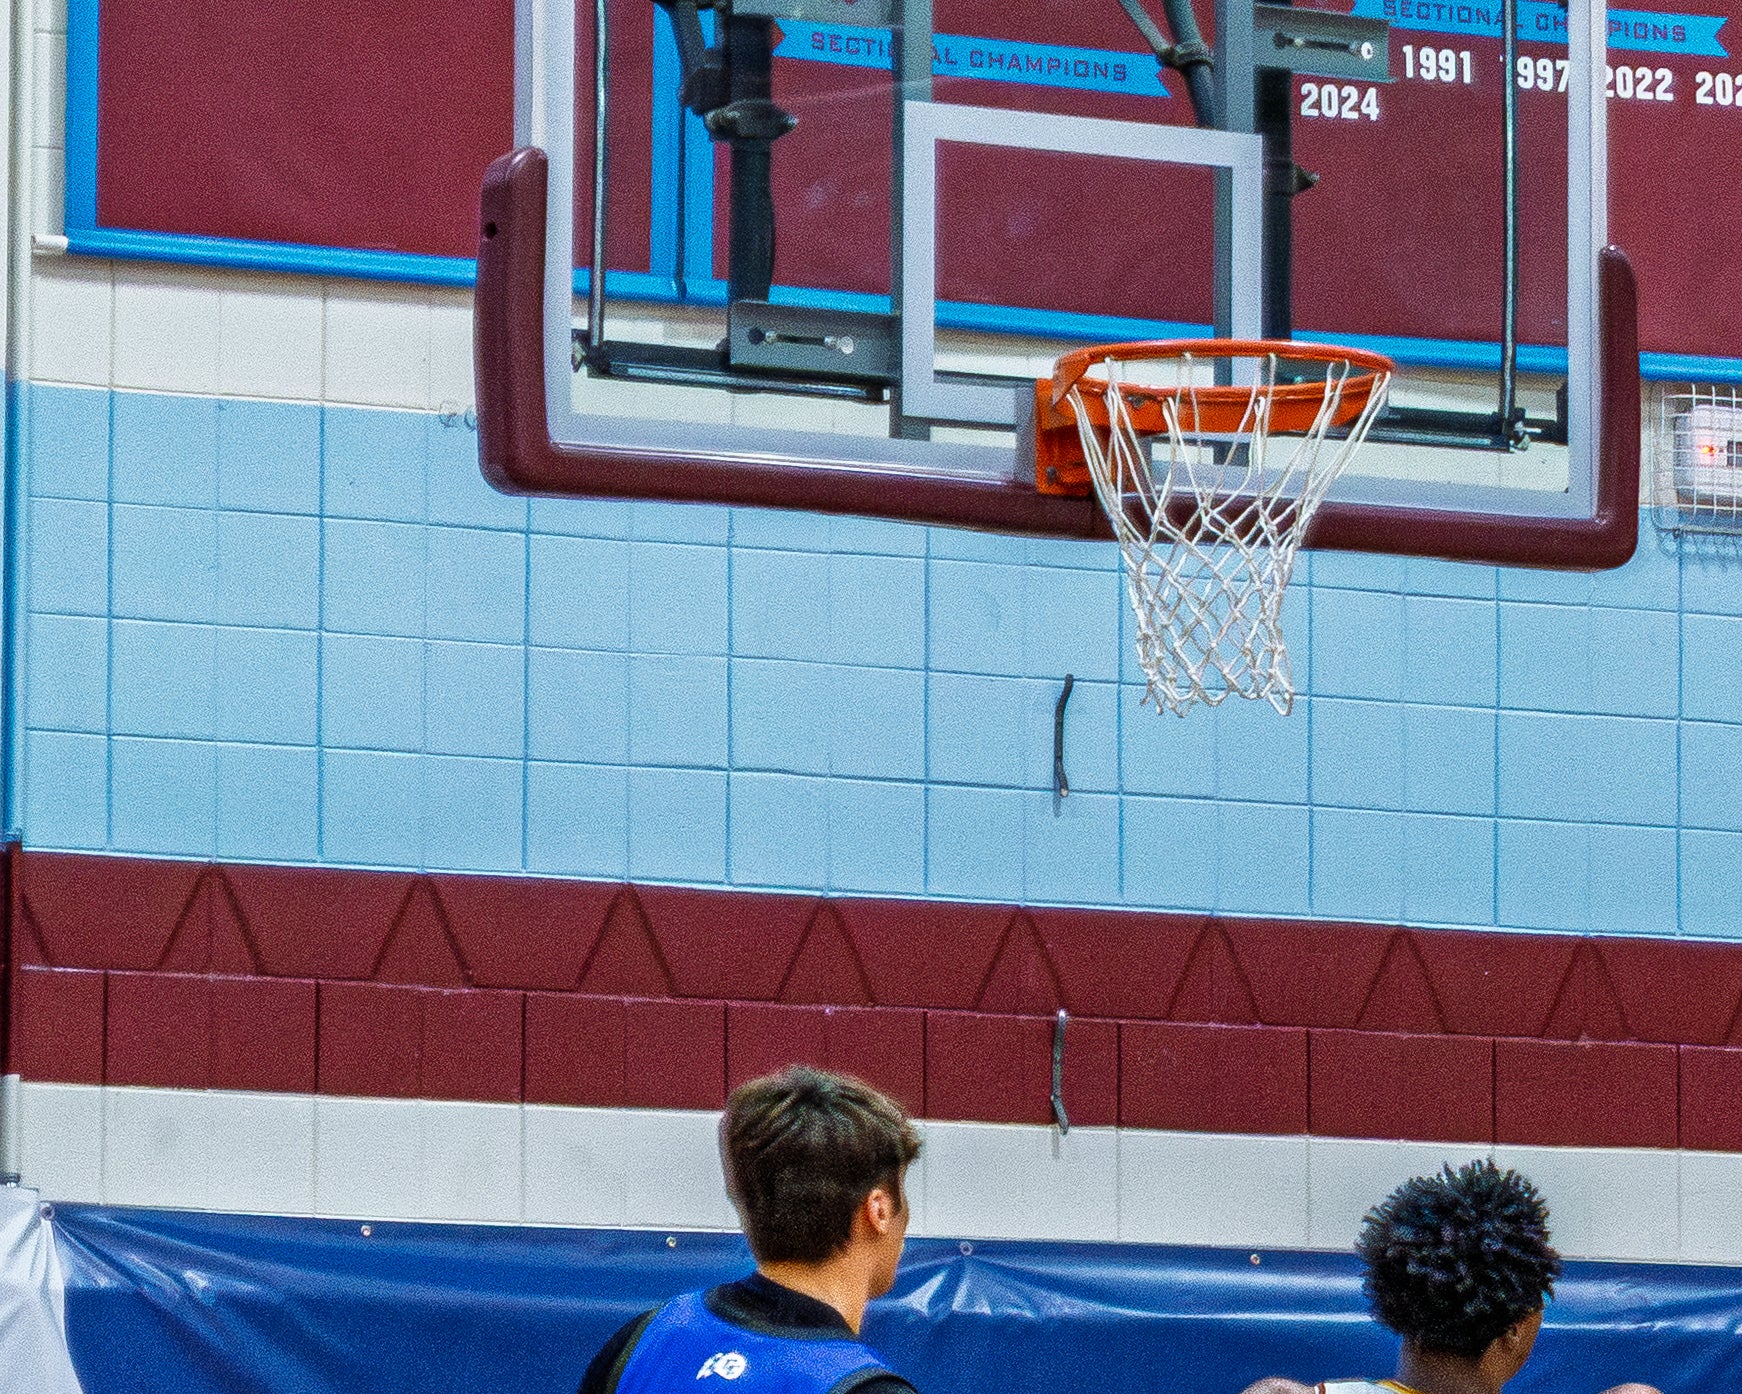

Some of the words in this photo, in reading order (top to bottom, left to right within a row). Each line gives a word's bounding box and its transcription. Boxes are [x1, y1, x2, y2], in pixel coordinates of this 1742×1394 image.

[1384, 0, 1524, 28] SECTION
[1535, 13, 1686, 43] CHPIONS
[811, 31, 957, 65] SECTIAL
[969, 49, 1127, 82] CHAMPIONS
[1402, 45, 1471, 84] 1991
[1500, 55, 1569, 93] 997
[1300, 83, 1380, 121] 2024
